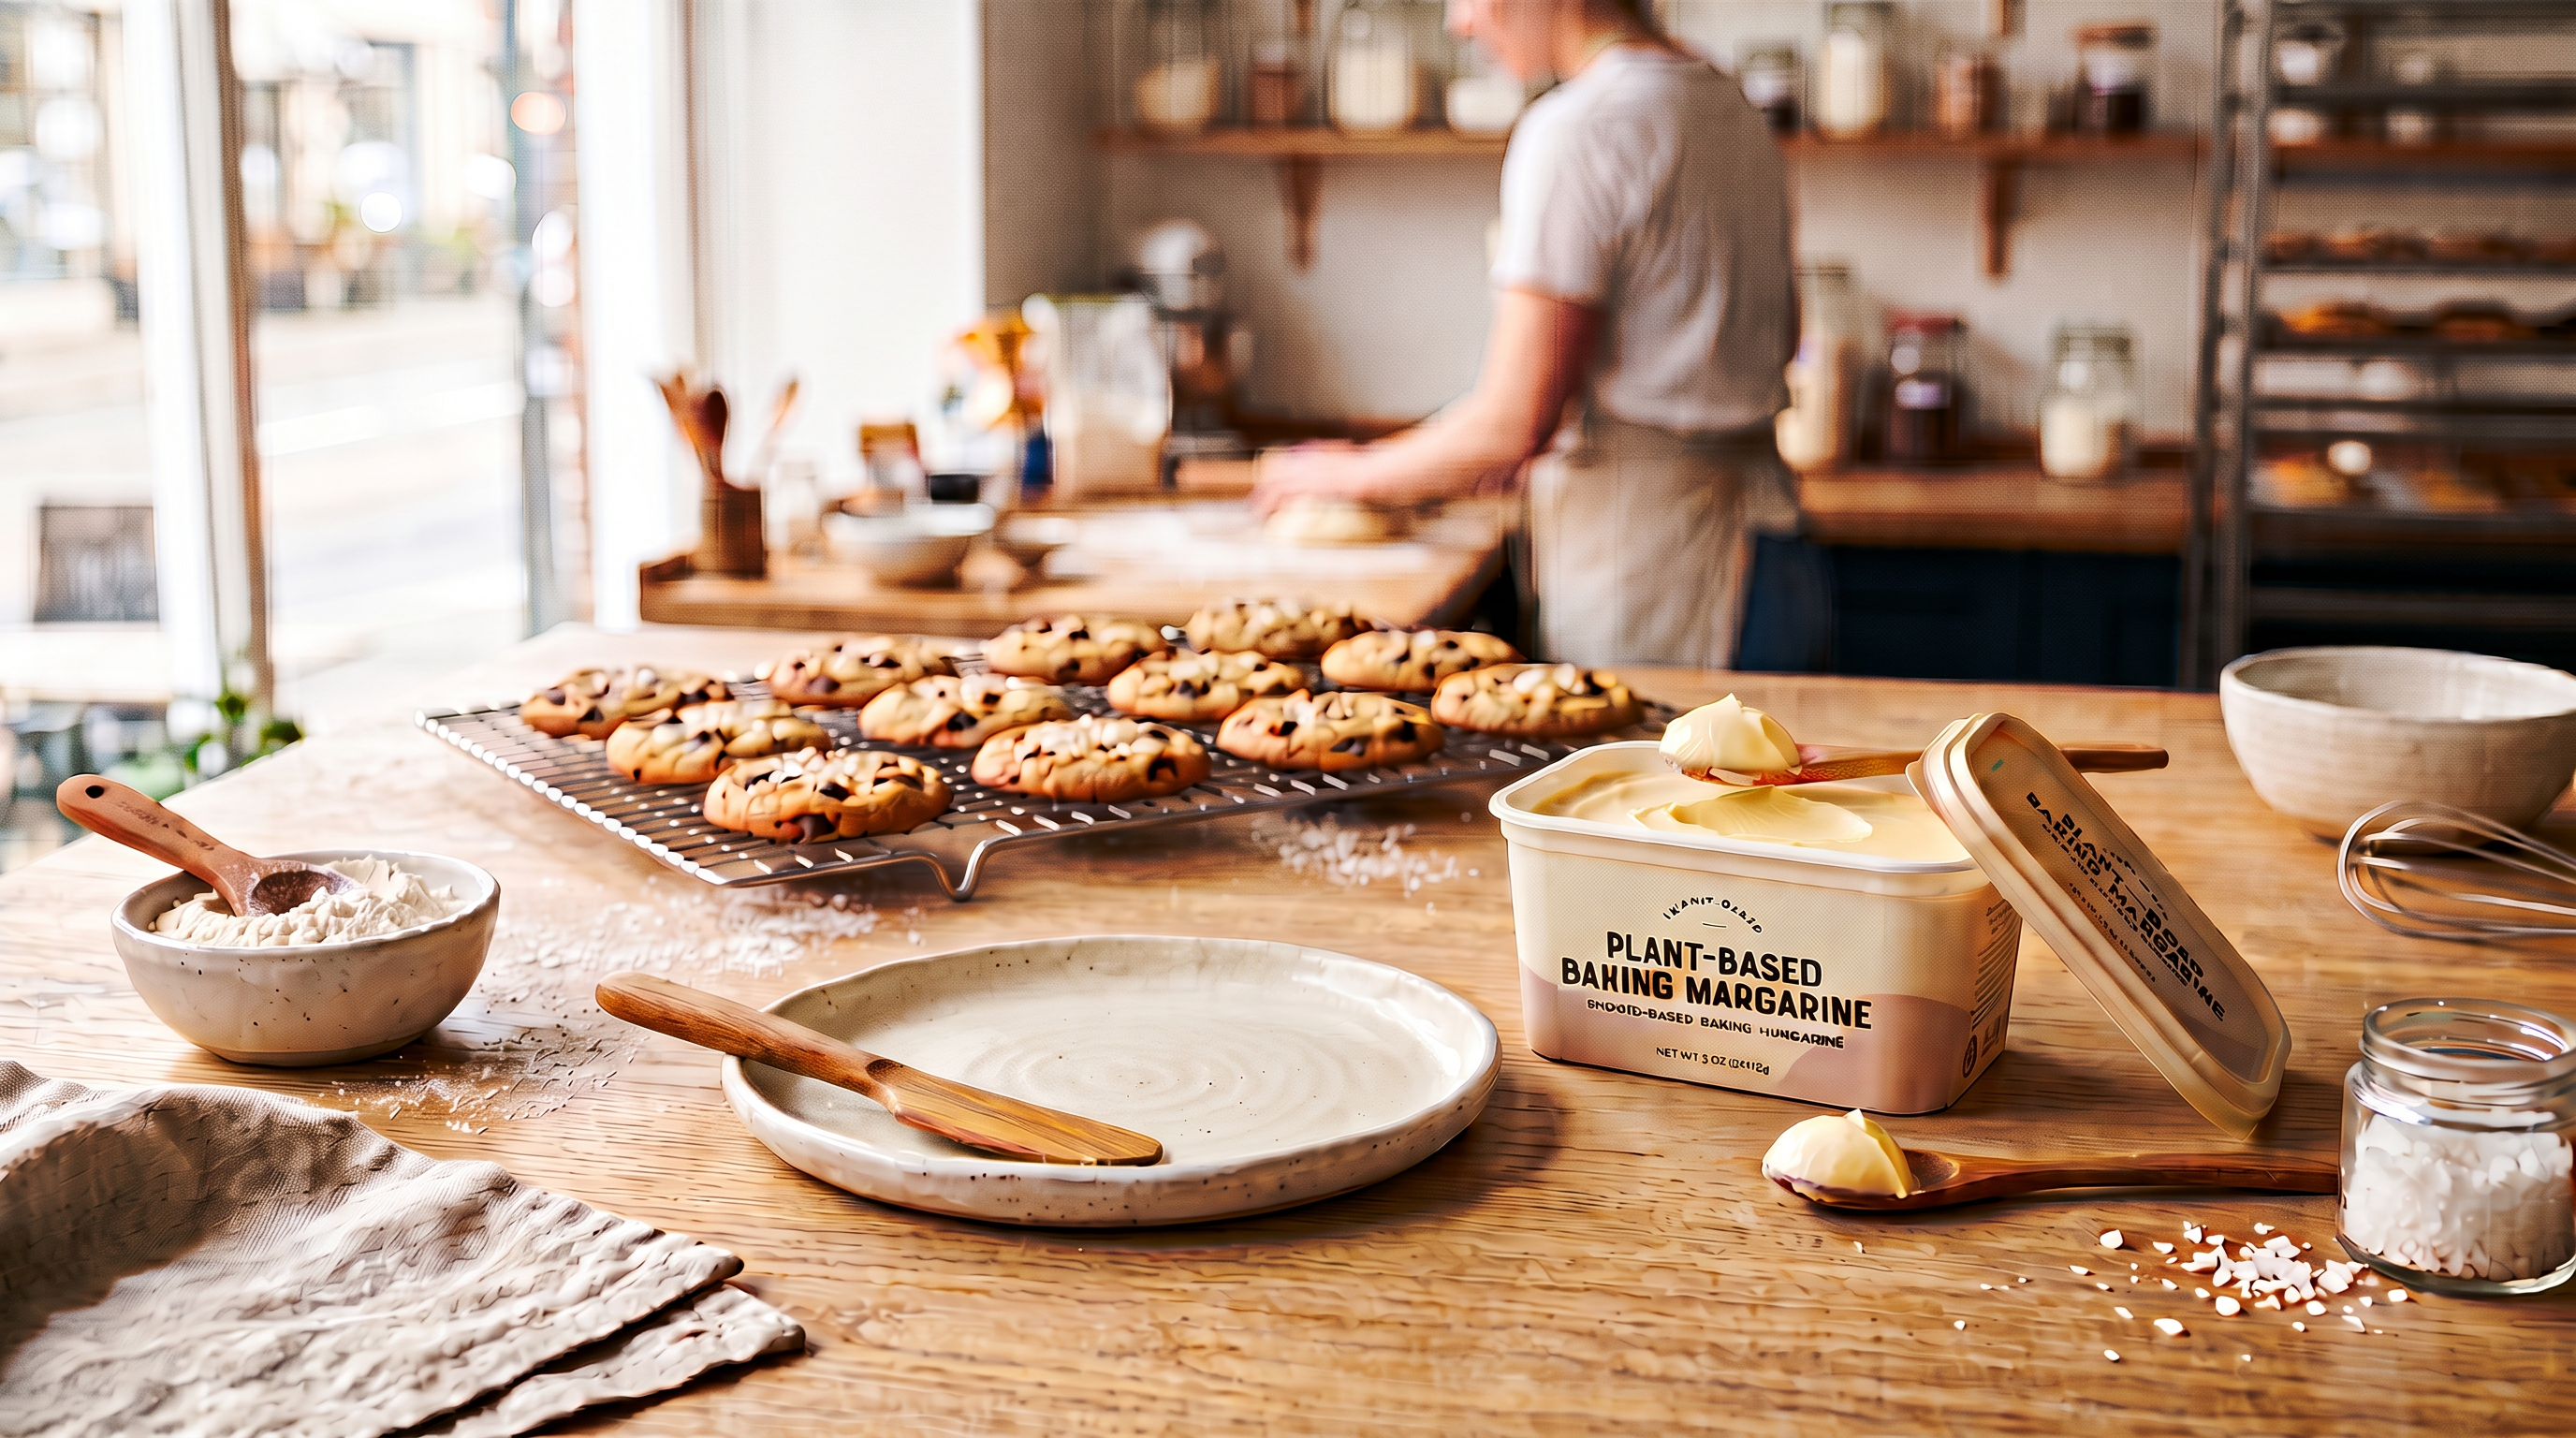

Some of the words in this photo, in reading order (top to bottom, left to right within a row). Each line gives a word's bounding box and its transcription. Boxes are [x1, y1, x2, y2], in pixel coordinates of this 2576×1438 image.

[1606, 931, 1822, 987] PLANT-BASED
[1561, 957, 1674, 1000] BAKING
[1686, 976, 1872, 1030] MARGARINE
[1700, 1017, 1752, 1035] BAKING
[1656, 1047, 1678, 1059] NET
[1680, 1050, 1699, 1062] WT
[1710, 1055, 1727, 1066] OZ
